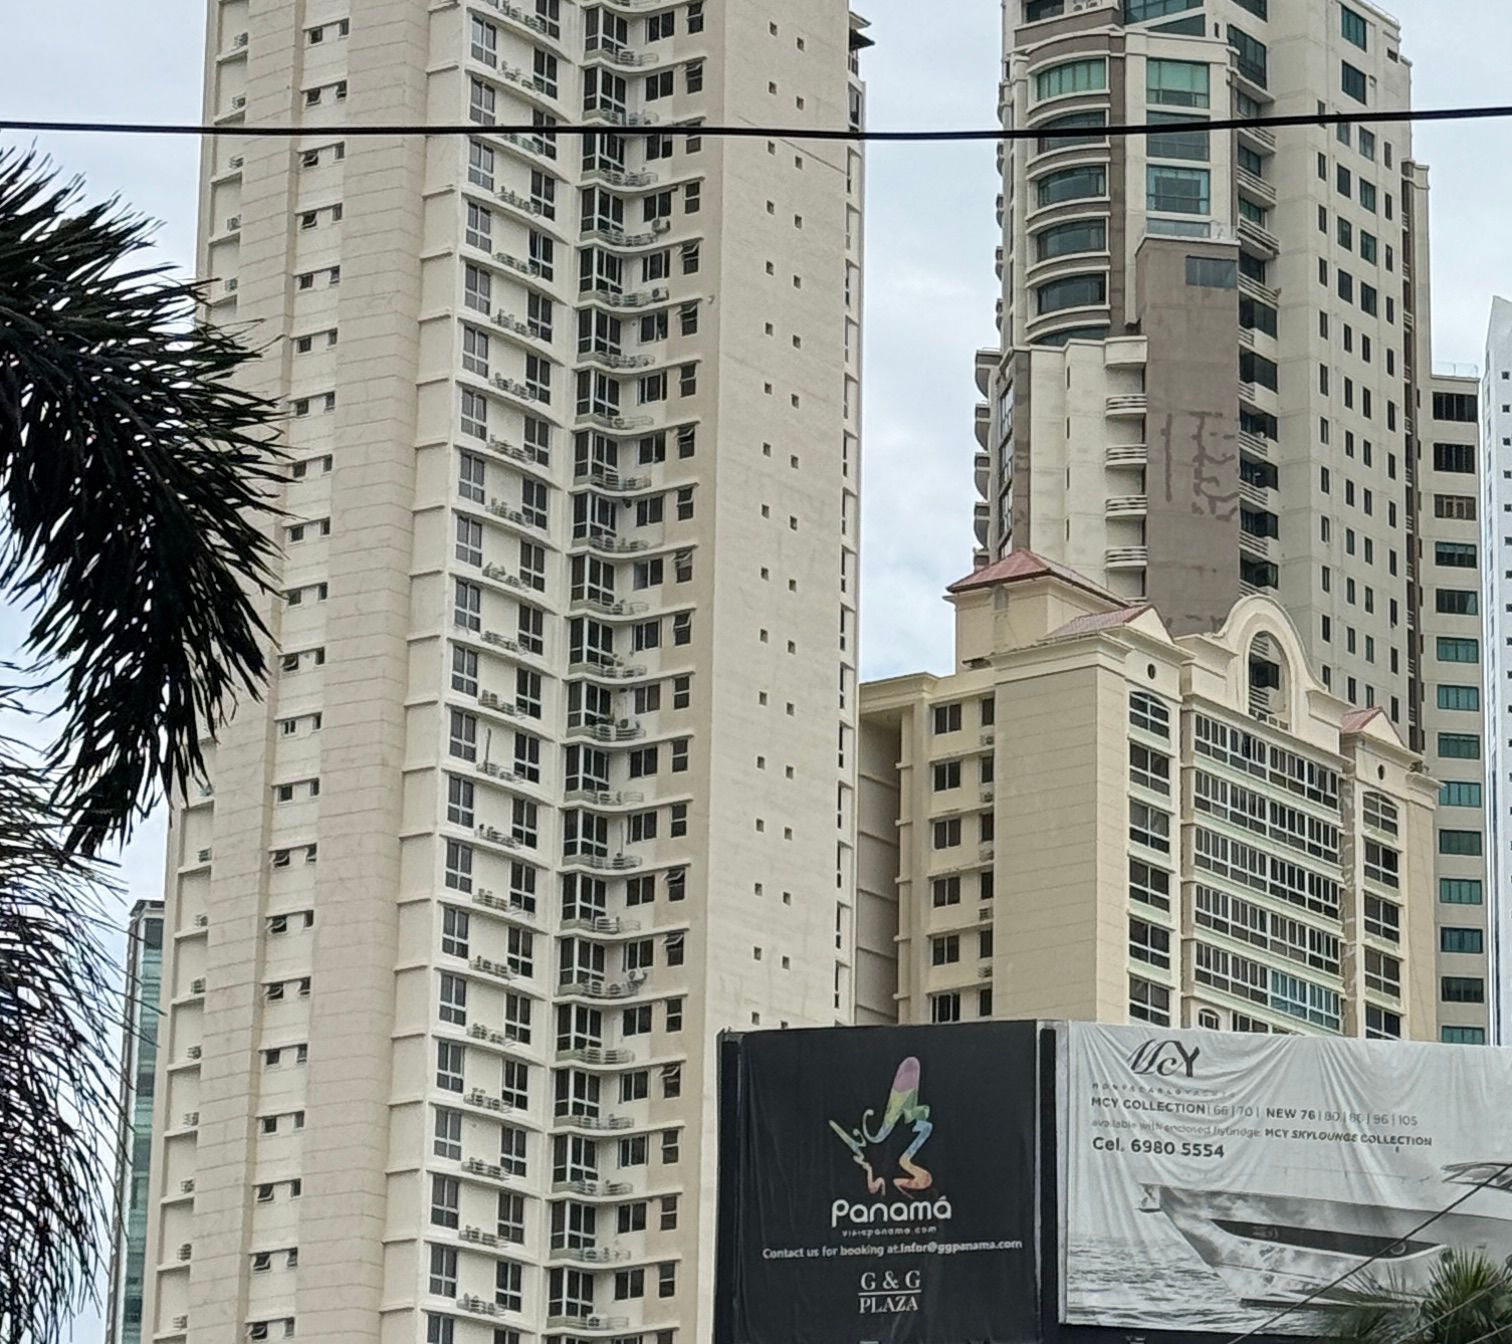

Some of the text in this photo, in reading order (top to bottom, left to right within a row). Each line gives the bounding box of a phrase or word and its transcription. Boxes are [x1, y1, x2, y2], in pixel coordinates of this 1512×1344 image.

[1091, 1096, 1119, 1109] MCY
[1123, 1098, 1206, 1115] COLLECTION
[1266, 1107, 1297, 1120] NEW
[1092, 1136, 1225, 1158] Cel. 6980 5554
[1264, 1128, 1289, 1139] MCY
[1291, 1130, 1358, 1143] SKYLOUNGE
[1360, 1133, 1432, 1146] COLLECTION
[830, 1195, 952, 1228] Panamá
[763, 1247, 804, 1260] Contact
[807, 1248, 820, 1258] us
[822, 1245, 838, 1258] for
[840, 1243, 884, 1259] booking
[860, 1269, 921, 1291] G & G
[859, 1296, 919, 1314] PLAZA
